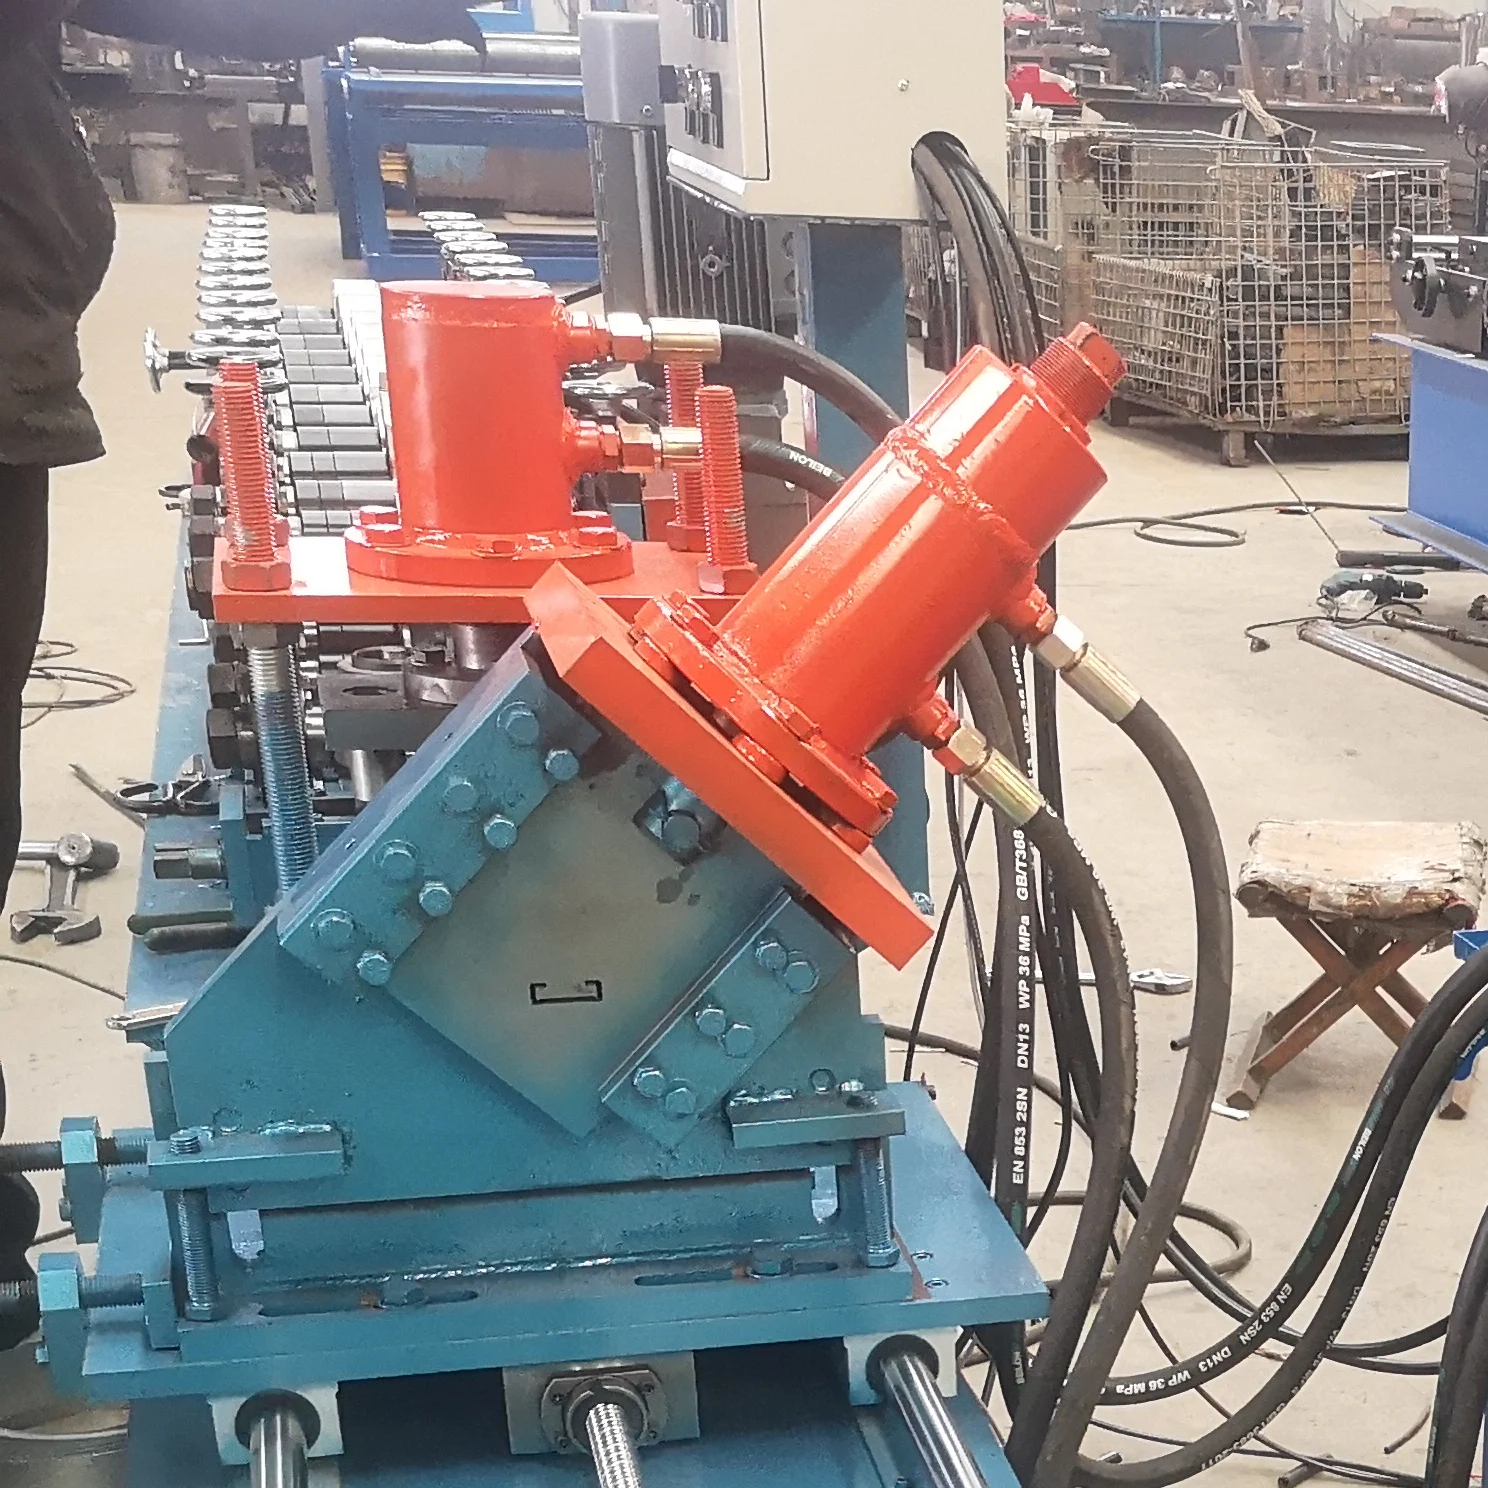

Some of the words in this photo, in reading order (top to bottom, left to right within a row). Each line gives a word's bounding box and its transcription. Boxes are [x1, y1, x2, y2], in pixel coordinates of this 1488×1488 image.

[788, 450, 833, 478] BEILON
[1018, 915, 1031, 952] MPa
[1018, 955, 1031, 981] 36
[1018, 982, 1031, 1010] WP
[1016, 1023, 1030, 1069] DN13
[1015, 1087, 1029, 1123] 2SN
[1014, 1126, 1027, 1156] 853
[1012, 1160, 1025, 1185] EN
[1276, 1283, 1292, 1304] EN
[1260, 1301, 1280, 1323] 853
[1239, 1319, 1263, 1345] 2SN
[1198, 1346, 1232, 1373] DN13
[1115, 1382, 1146, 1395] MPa
[1148, 1378, 1166, 1391] 36
[1168, 1370, 1192, 1387] WP
